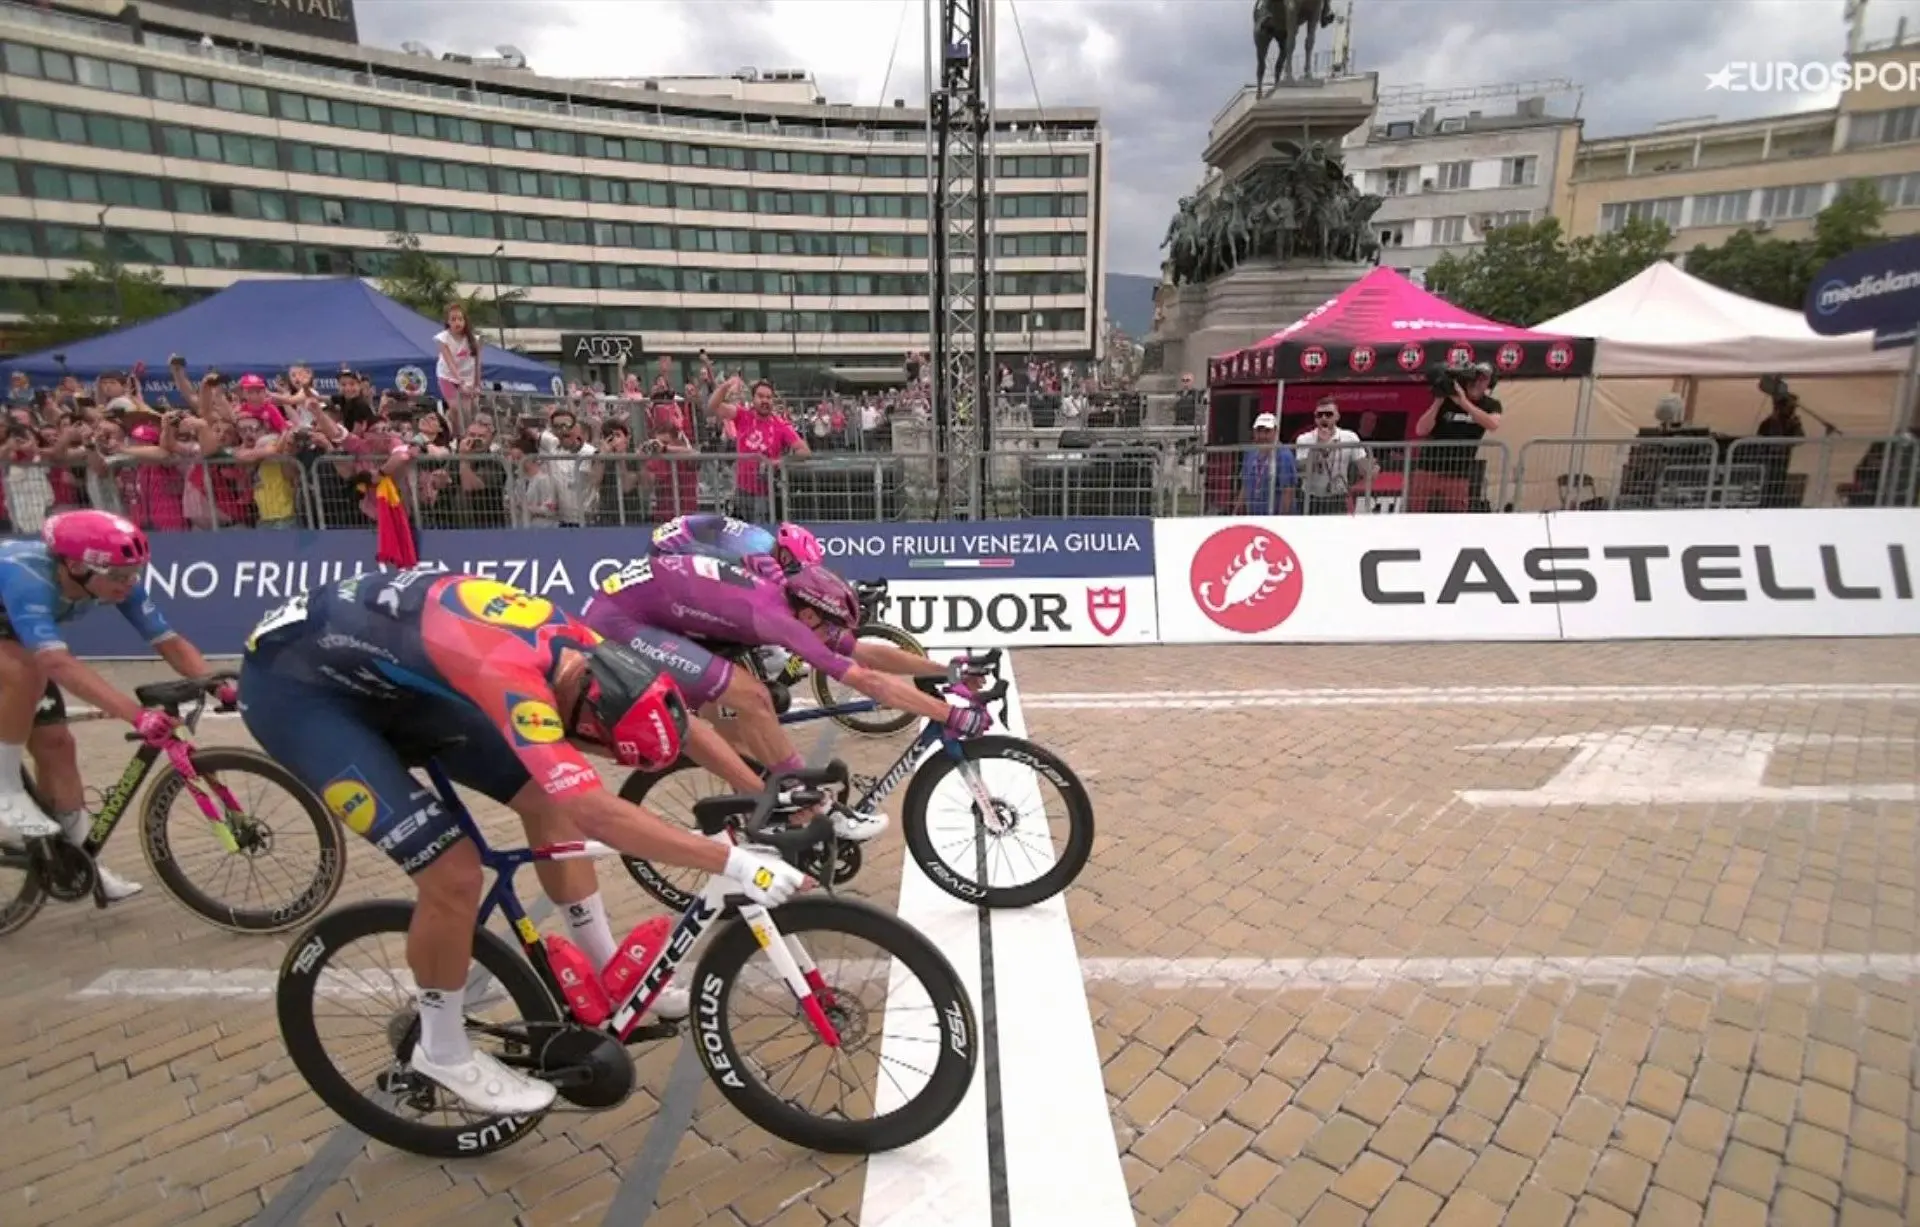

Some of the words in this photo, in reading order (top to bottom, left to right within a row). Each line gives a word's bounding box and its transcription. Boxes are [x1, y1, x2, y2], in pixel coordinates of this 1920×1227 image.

[819, 535, 886, 557] SONO
[892, 534, 957, 556] FRIULI
[962, 533, 1059, 555] VENEZIA
[1064, 532, 1141, 553] GIULIA
[1360, 543, 1913, 605] CASTELLI
[629, 636, 701, 675] QUICK-STEP
[376, 801, 443, 850] REK
[611, 895, 721, 1033] TREK
[700, 972, 747, 1089] AEOLUS
[943, 1000, 968, 1060] RSL
